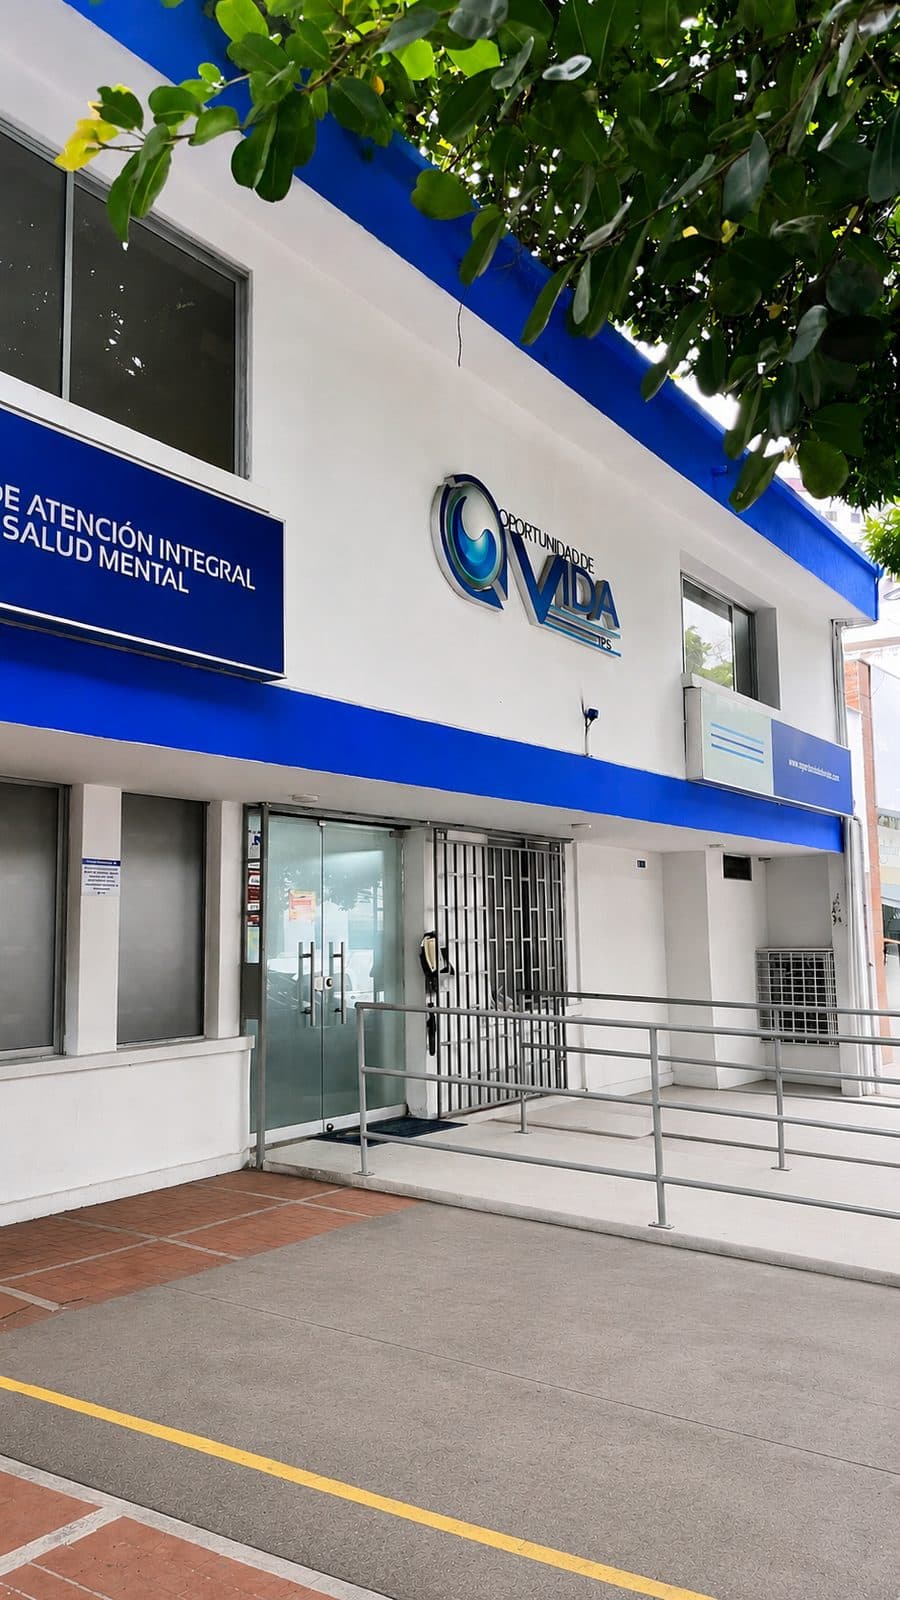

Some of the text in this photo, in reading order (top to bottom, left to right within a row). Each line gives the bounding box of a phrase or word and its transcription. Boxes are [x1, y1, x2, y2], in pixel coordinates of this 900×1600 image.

[0, 484, 256, 590] E ATENCIÓN INTEGRAL
[3, 515, 189, 594] SALUD MENTAL
[499, 509, 595, 575] OPORTUNIDAD DE
[506, 529, 620, 630] VIDA
